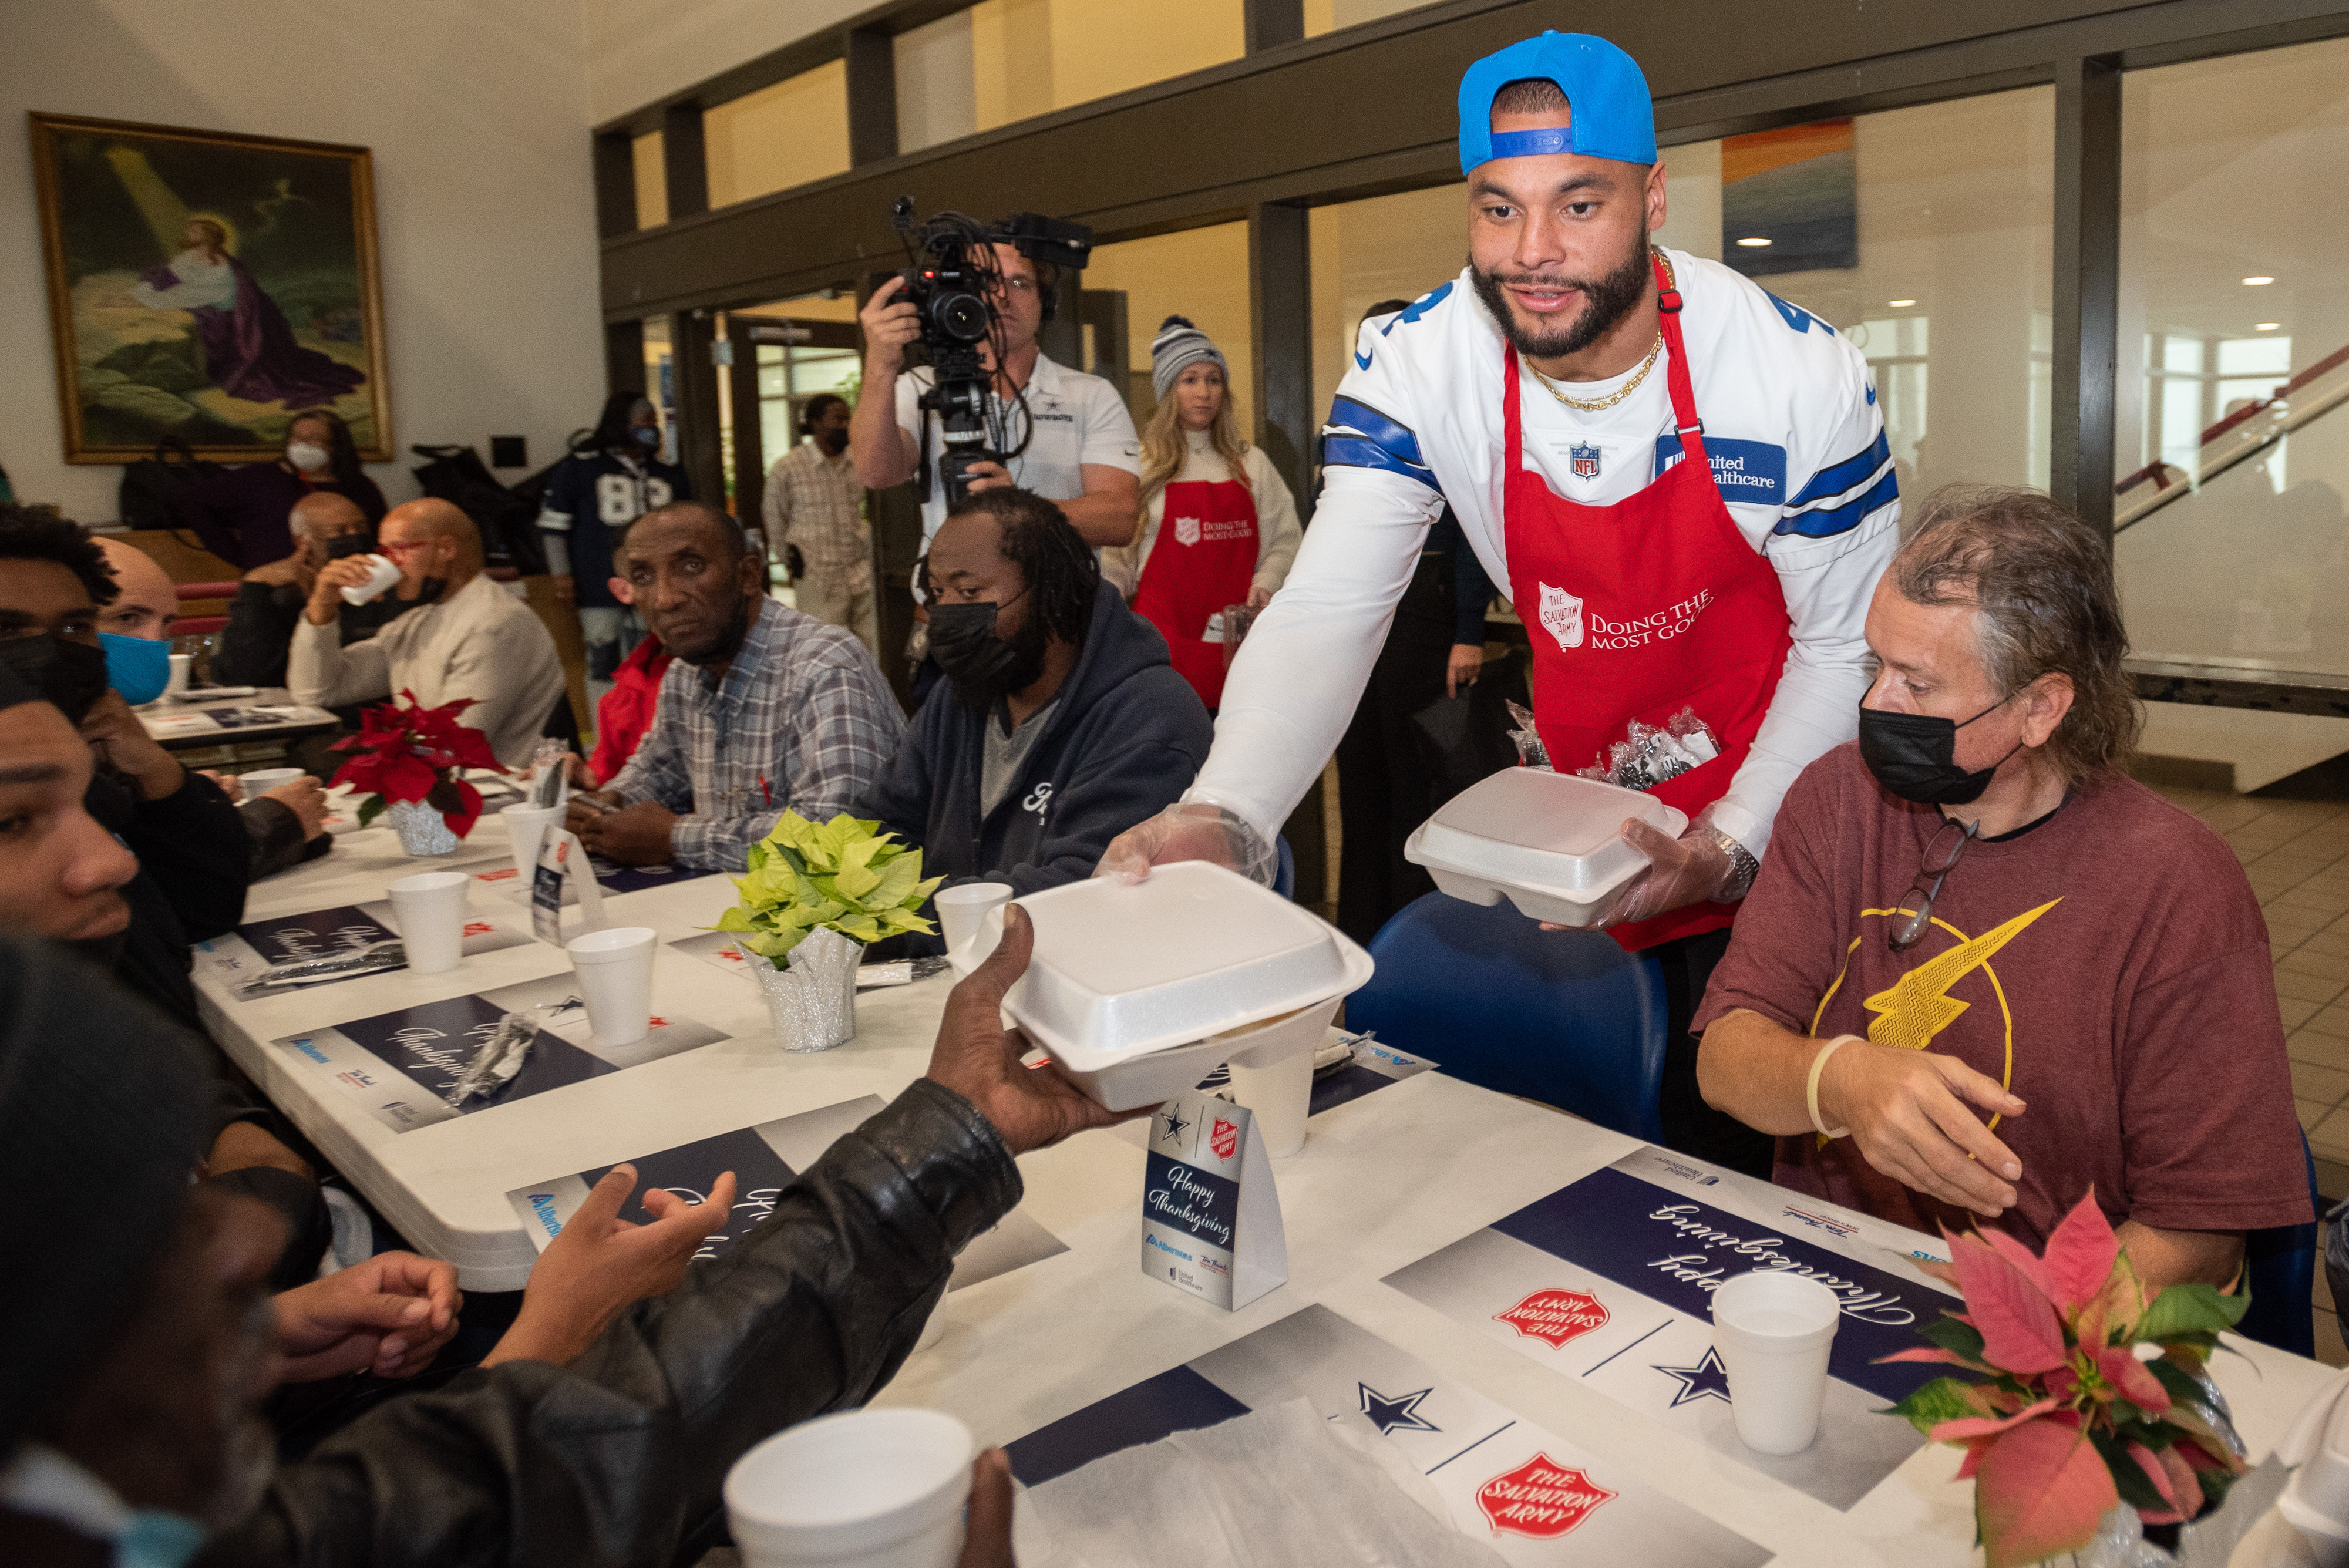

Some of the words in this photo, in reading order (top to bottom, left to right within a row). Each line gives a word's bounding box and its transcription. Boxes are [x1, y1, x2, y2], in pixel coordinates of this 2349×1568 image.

[1575, 460, 1597, 475] NFL
[1707, 455, 1745, 470] nited
[1714, 470, 1775, 489] althcare
[1203, 521, 1233, 531] DOING
[1234, 519, 1248, 528] THE
[1203, 531, 1228, 541] MOST
[1229, 527, 1253, 539] GOOD
[1549, 594, 1565, 606] THE
[1544, 604, 1579, 624] SALVATION
[1591, 613, 1667, 635] DOING
[1670, 588, 1708, 620] THE
[1556, 620, 1577, 637] ARMY
[1591, 631, 1652, 650] MOST
[1211, 1128, 1236, 1147] SALVATION
[1217, 1123, 1228, 1135] THE
[1218, 1140, 1234, 1155] ARMY
[1655, 1157, 1704, 1177] Healthcare
[1664, 1167, 1697, 1181] United
[1167, 1166, 1215, 1208] Happy
[1149, 1189, 1230, 1244] Thanksgiving
[1782, 1210, 1824, 1229] Thumb
[1825, 1224, 1849, 1239] Tom
[1528, 1297, 1593, 1313] ARMY
[1506, 1307, 1604, 1328] SALVATION
[1526, 1323, 1569, 1337] THE
[1526, 1468, 1577, 1488] THE
[1483, 1480, 1602, 1510] SALVATION
[1495, 1502, 1576, 1525] ARMY
